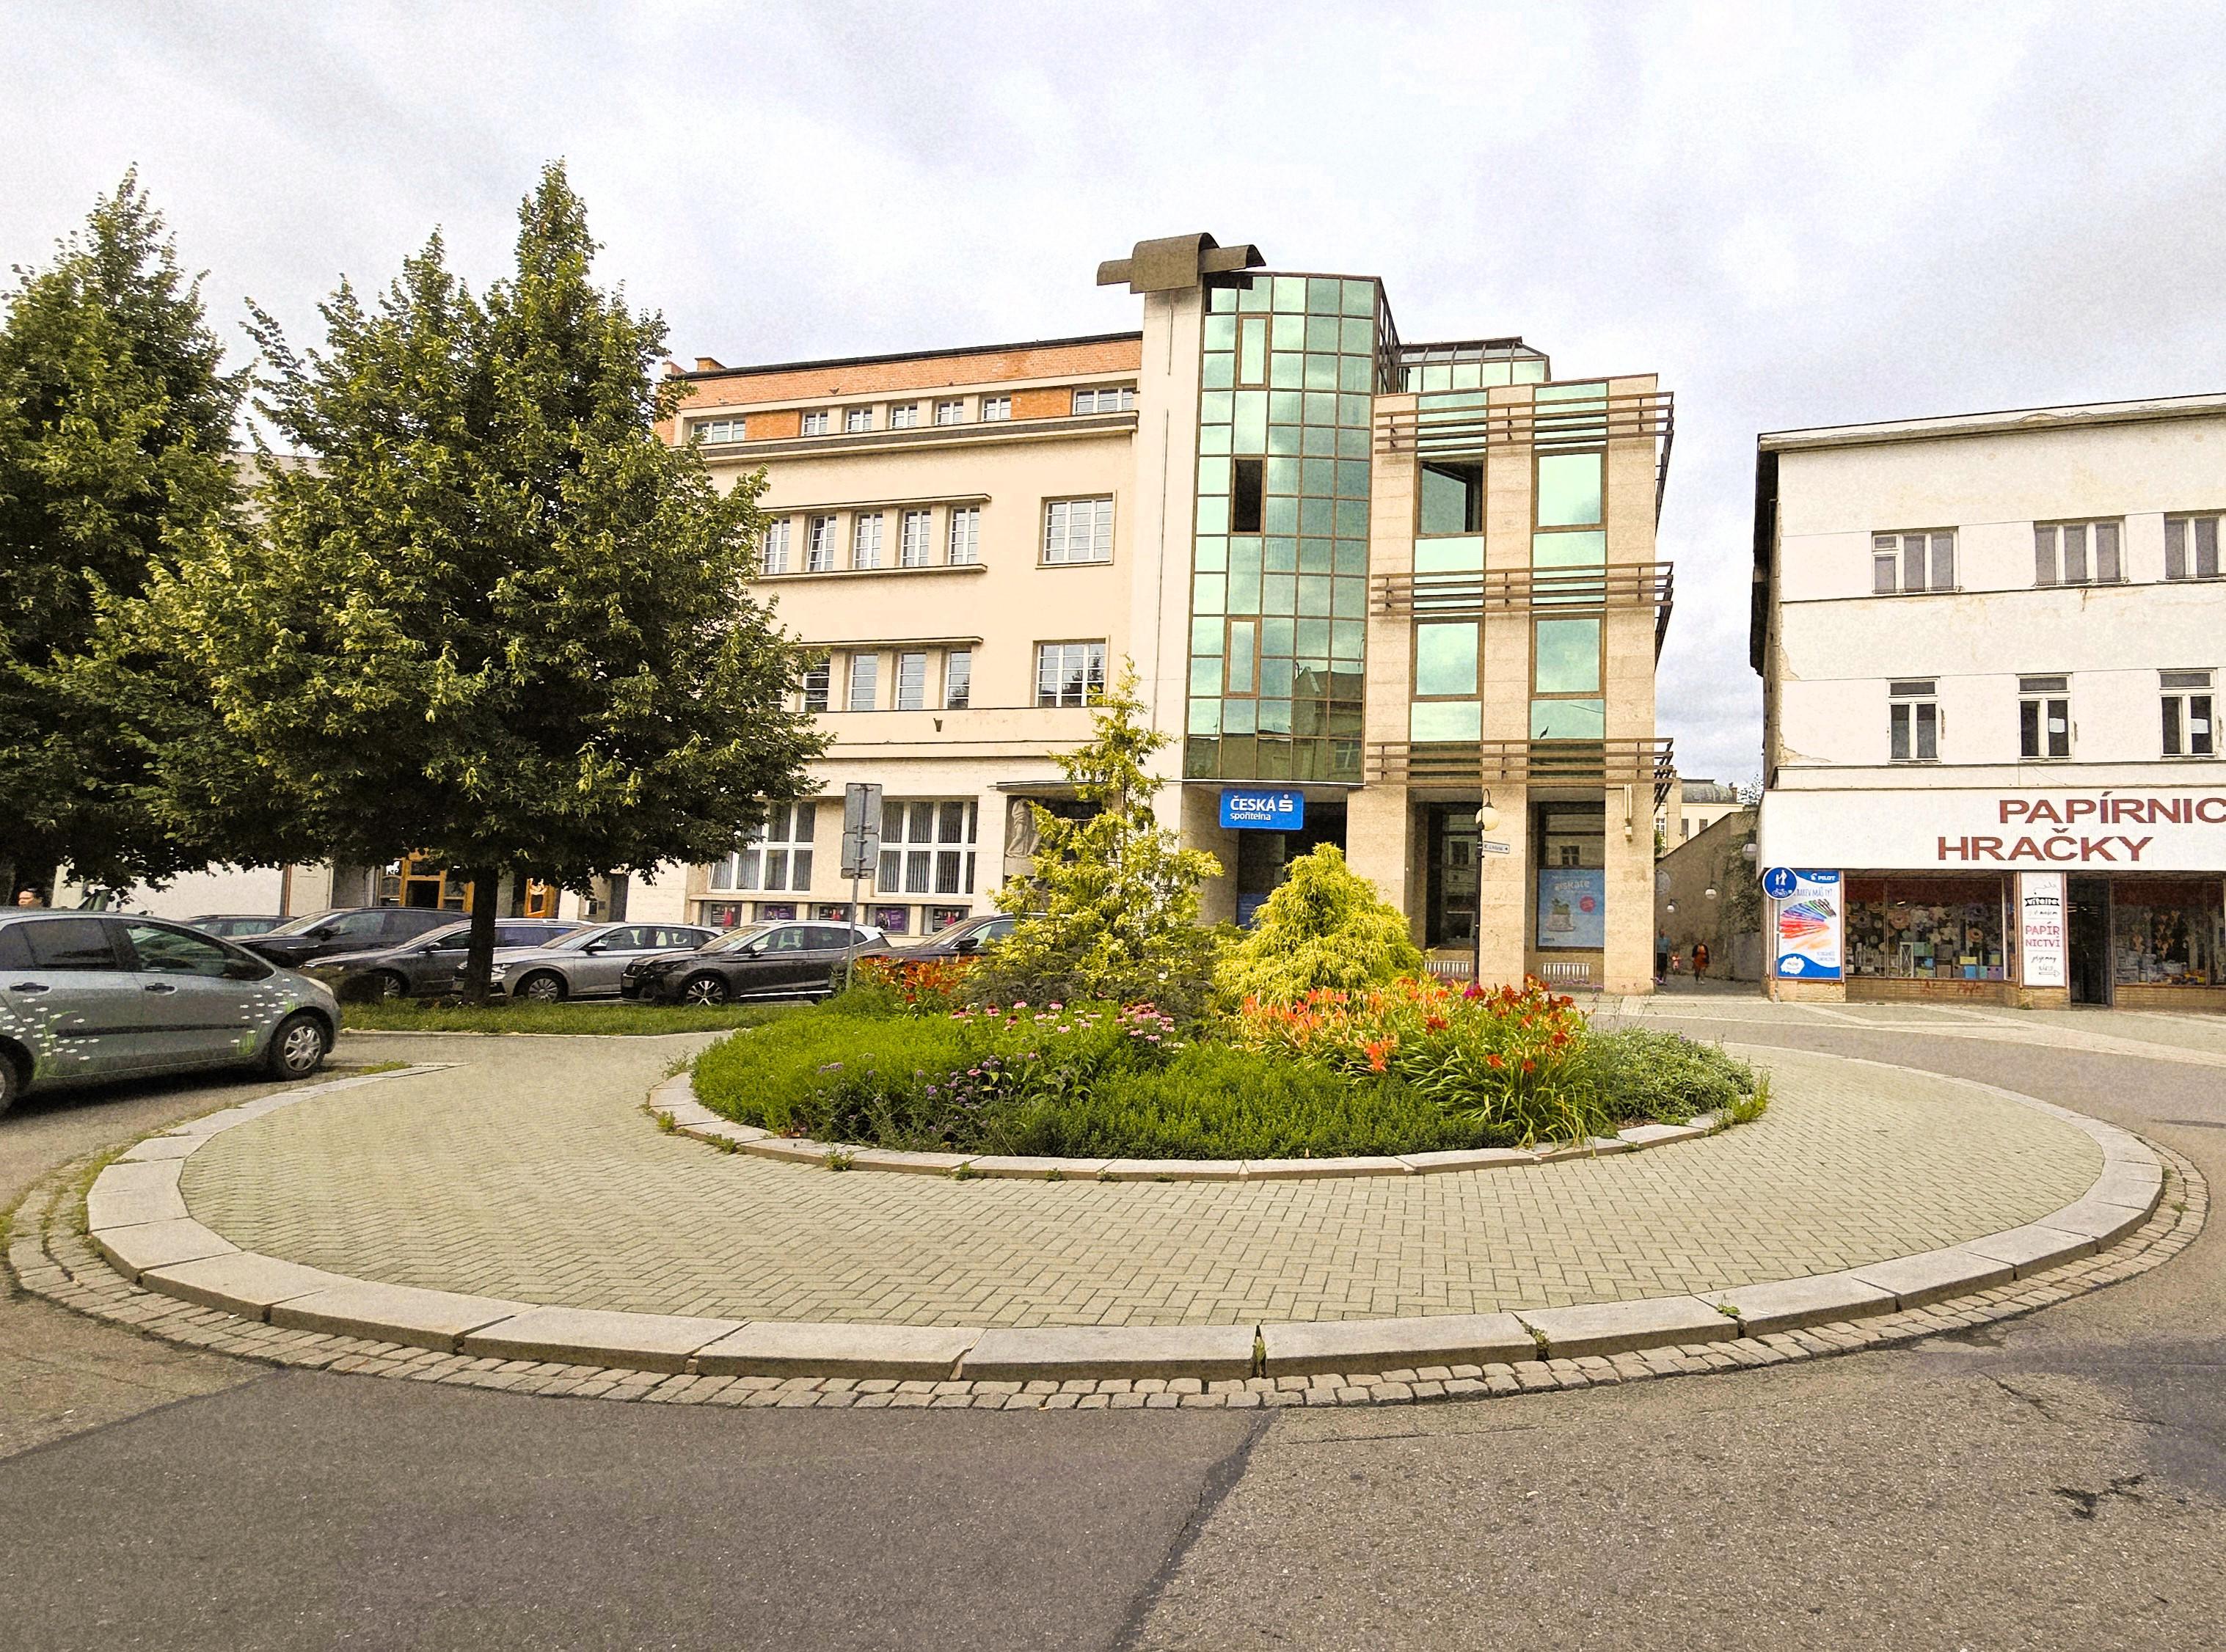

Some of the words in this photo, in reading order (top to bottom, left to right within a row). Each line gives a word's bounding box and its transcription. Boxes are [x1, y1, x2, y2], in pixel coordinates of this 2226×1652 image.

[1230, 794, 1277, 812] ČESKÁ
[1999, 791, 2226, 824] PAPÍRNIC
[1230, 812, 1271, 821] spořitelna
[1937, 827, 2155, 862] HRAČKY
[2025, 921, 2060, 935] PAPÍR
[2025, 935, 2061, 947] NICTVÍ
